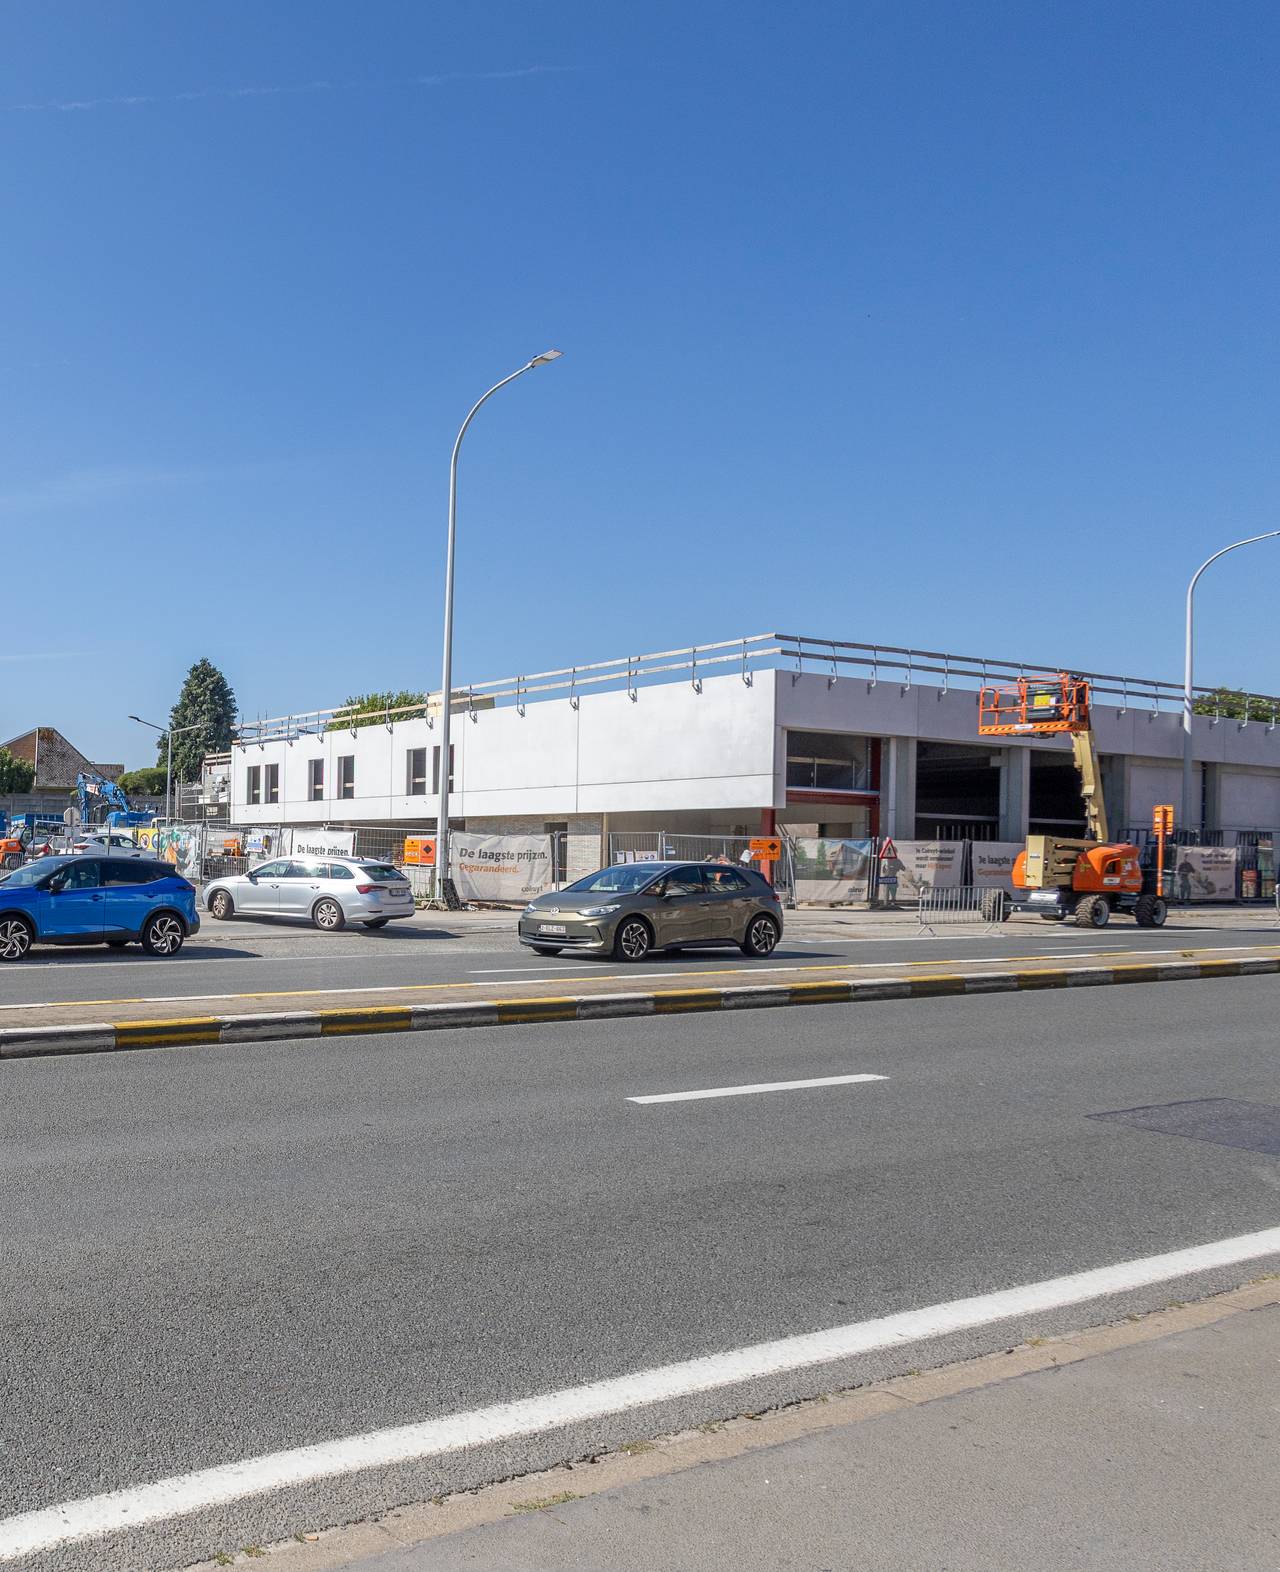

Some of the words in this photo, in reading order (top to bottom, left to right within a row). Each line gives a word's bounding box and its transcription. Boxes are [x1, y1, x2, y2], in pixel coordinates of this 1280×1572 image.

[297, 844, 306, 854] De
[307, 844, 326, 856] laagste
[460, 848, 475, 858] De
[478, 849, 515, 863] laagste
[459, 862, 520, 874] Gegarandeerd.
